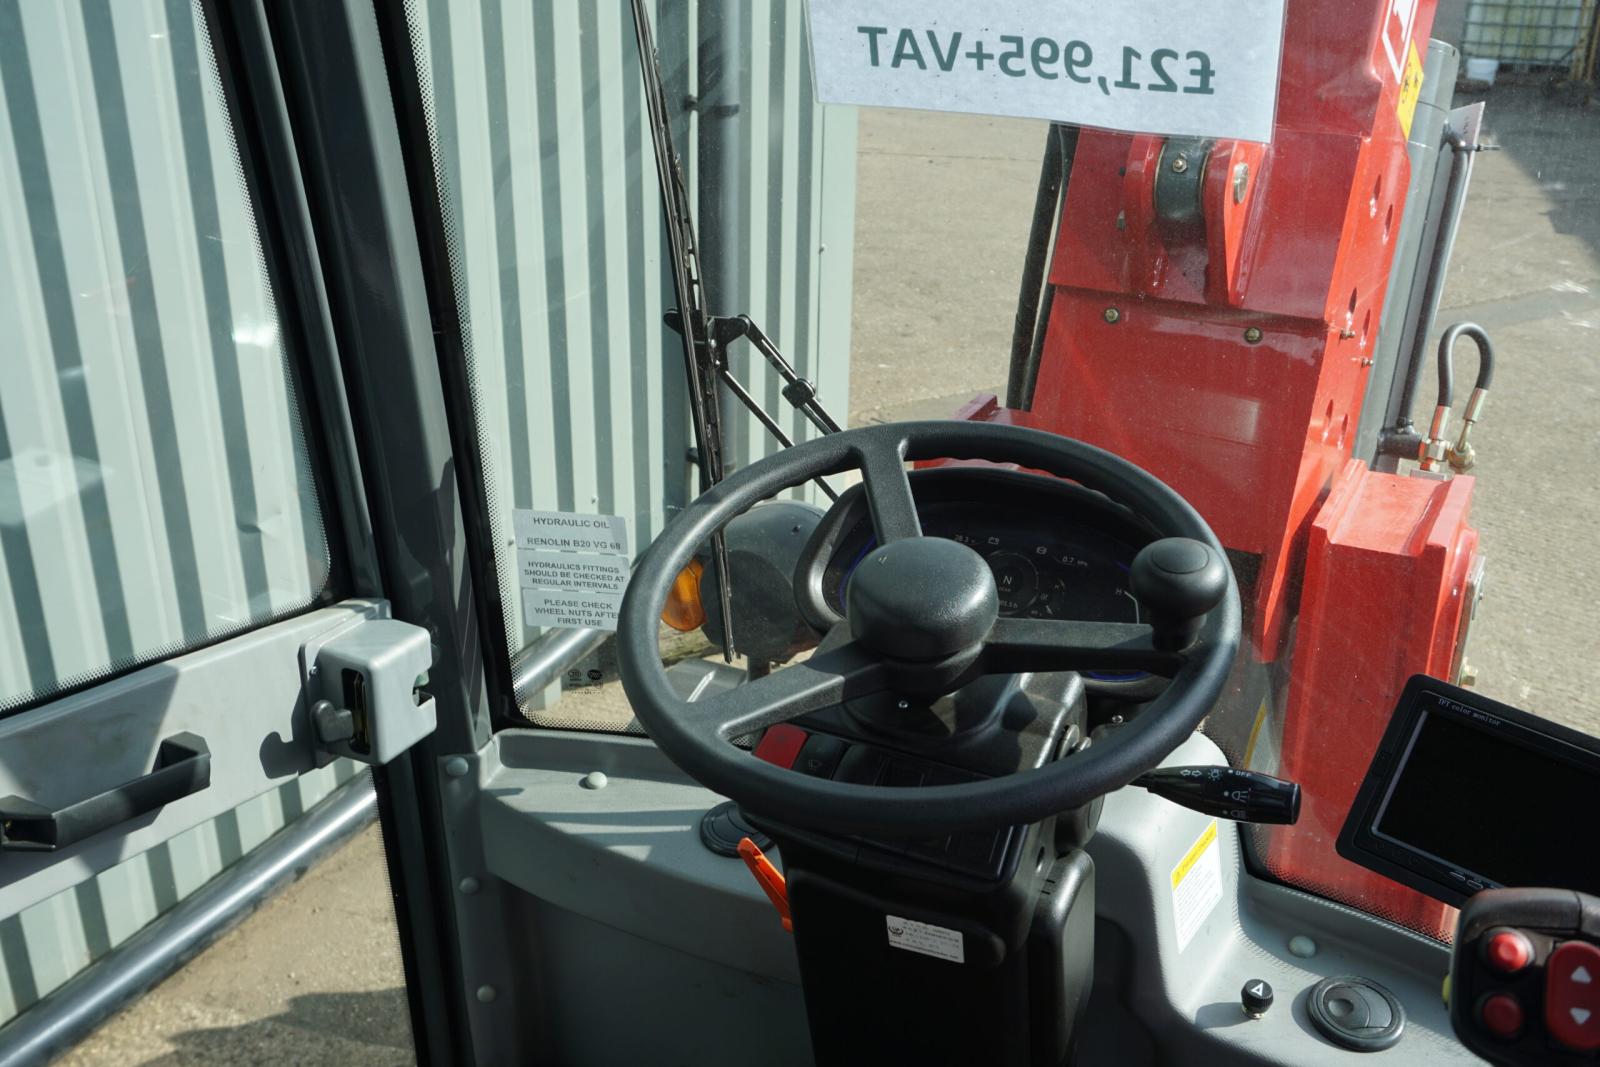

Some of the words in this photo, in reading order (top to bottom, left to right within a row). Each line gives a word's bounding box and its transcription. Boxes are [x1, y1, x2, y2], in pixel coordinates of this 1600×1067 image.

[533, 517, 591, 528] HYDRAULIC
[593, 520, 610, 529] OIL
[527, 537, 570, 547] RENOLIN
[573, 539, 591, 548] B20
[594, 541, 608, 550] VG
[528, 561, 580, 571] HYDRAULICS
[583, 565, 620, 574] FITTINGS
[524, 569, 558, 578] SHOULD
[573, 572, 613, 582] CHECKED
[614, 575, 625, 583] AT
[1003, 575, 1013, 585] N
[532, 577, 572, 587] REGULAR
[573, 580, 619, 590] INTERVALS
[544, 599, 579, 608] PLEASE
[581, 601, 613, 609] CHECK
[535, 607, 566, 616] WHEEL
[568, 609, 593, 617] NUTS
[594, 611, 619, 619] AFTE
[557, 617, 582, 626] FIRST
[584, 619, 603, 627] USE
[1452, 705, 1472, 715] color
[1473, 712, 1501, 726] monitor
